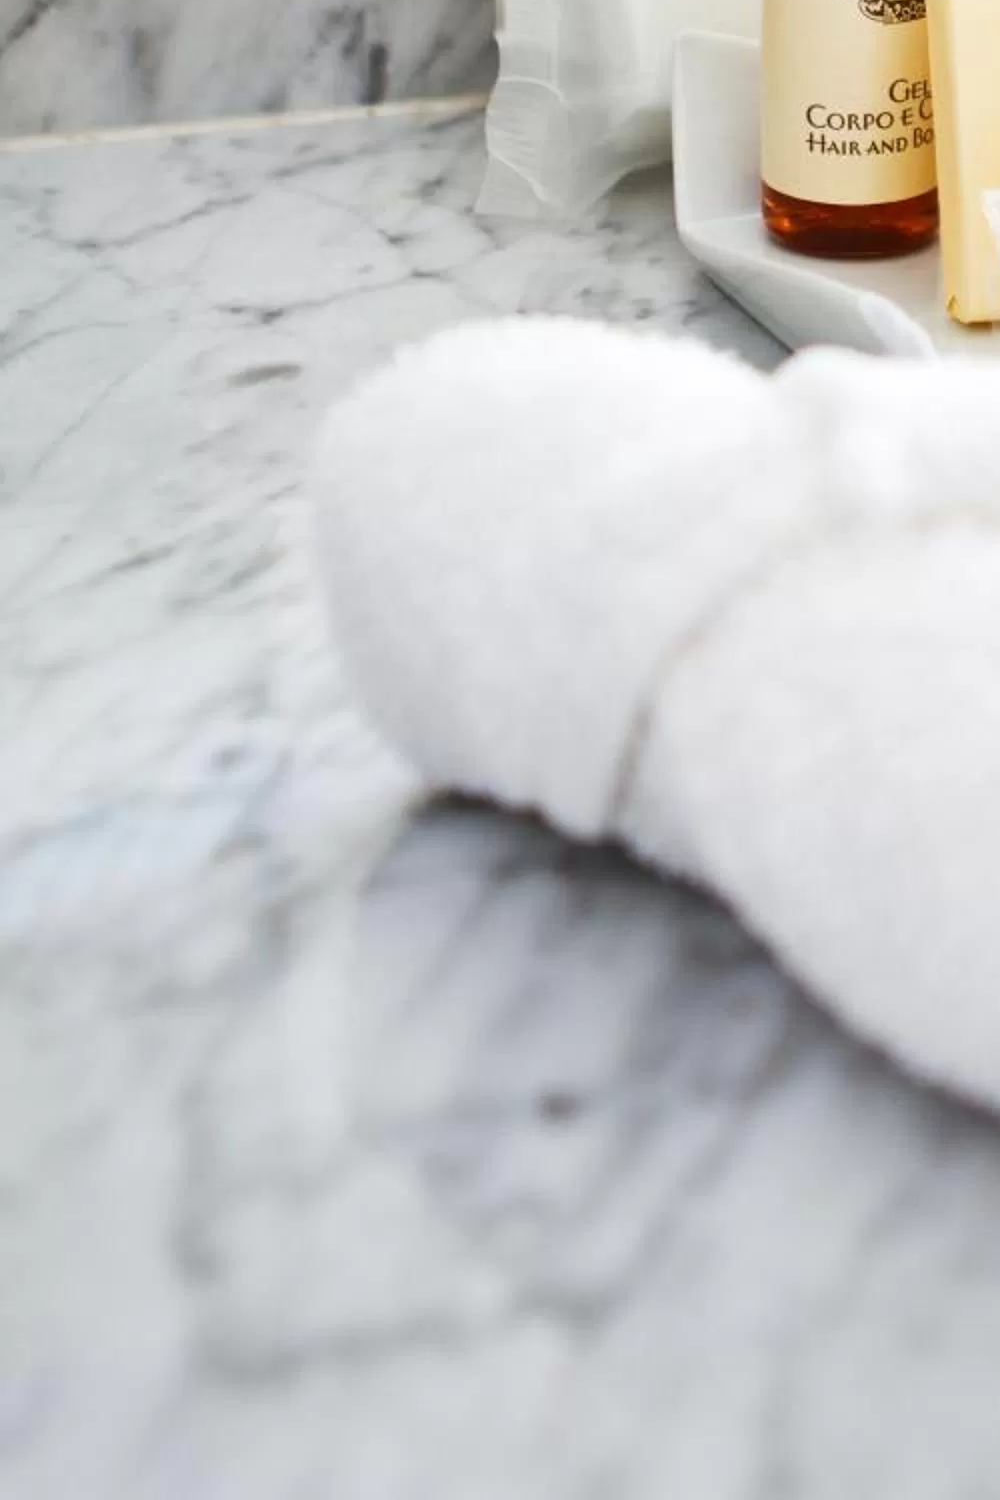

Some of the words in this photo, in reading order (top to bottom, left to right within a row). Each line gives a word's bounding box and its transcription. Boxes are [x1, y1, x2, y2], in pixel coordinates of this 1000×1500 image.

[805, 103, 895, 130] CORPO
[805, 132, 861, 156] HAIR
[867, 136, 908, 155] AND
